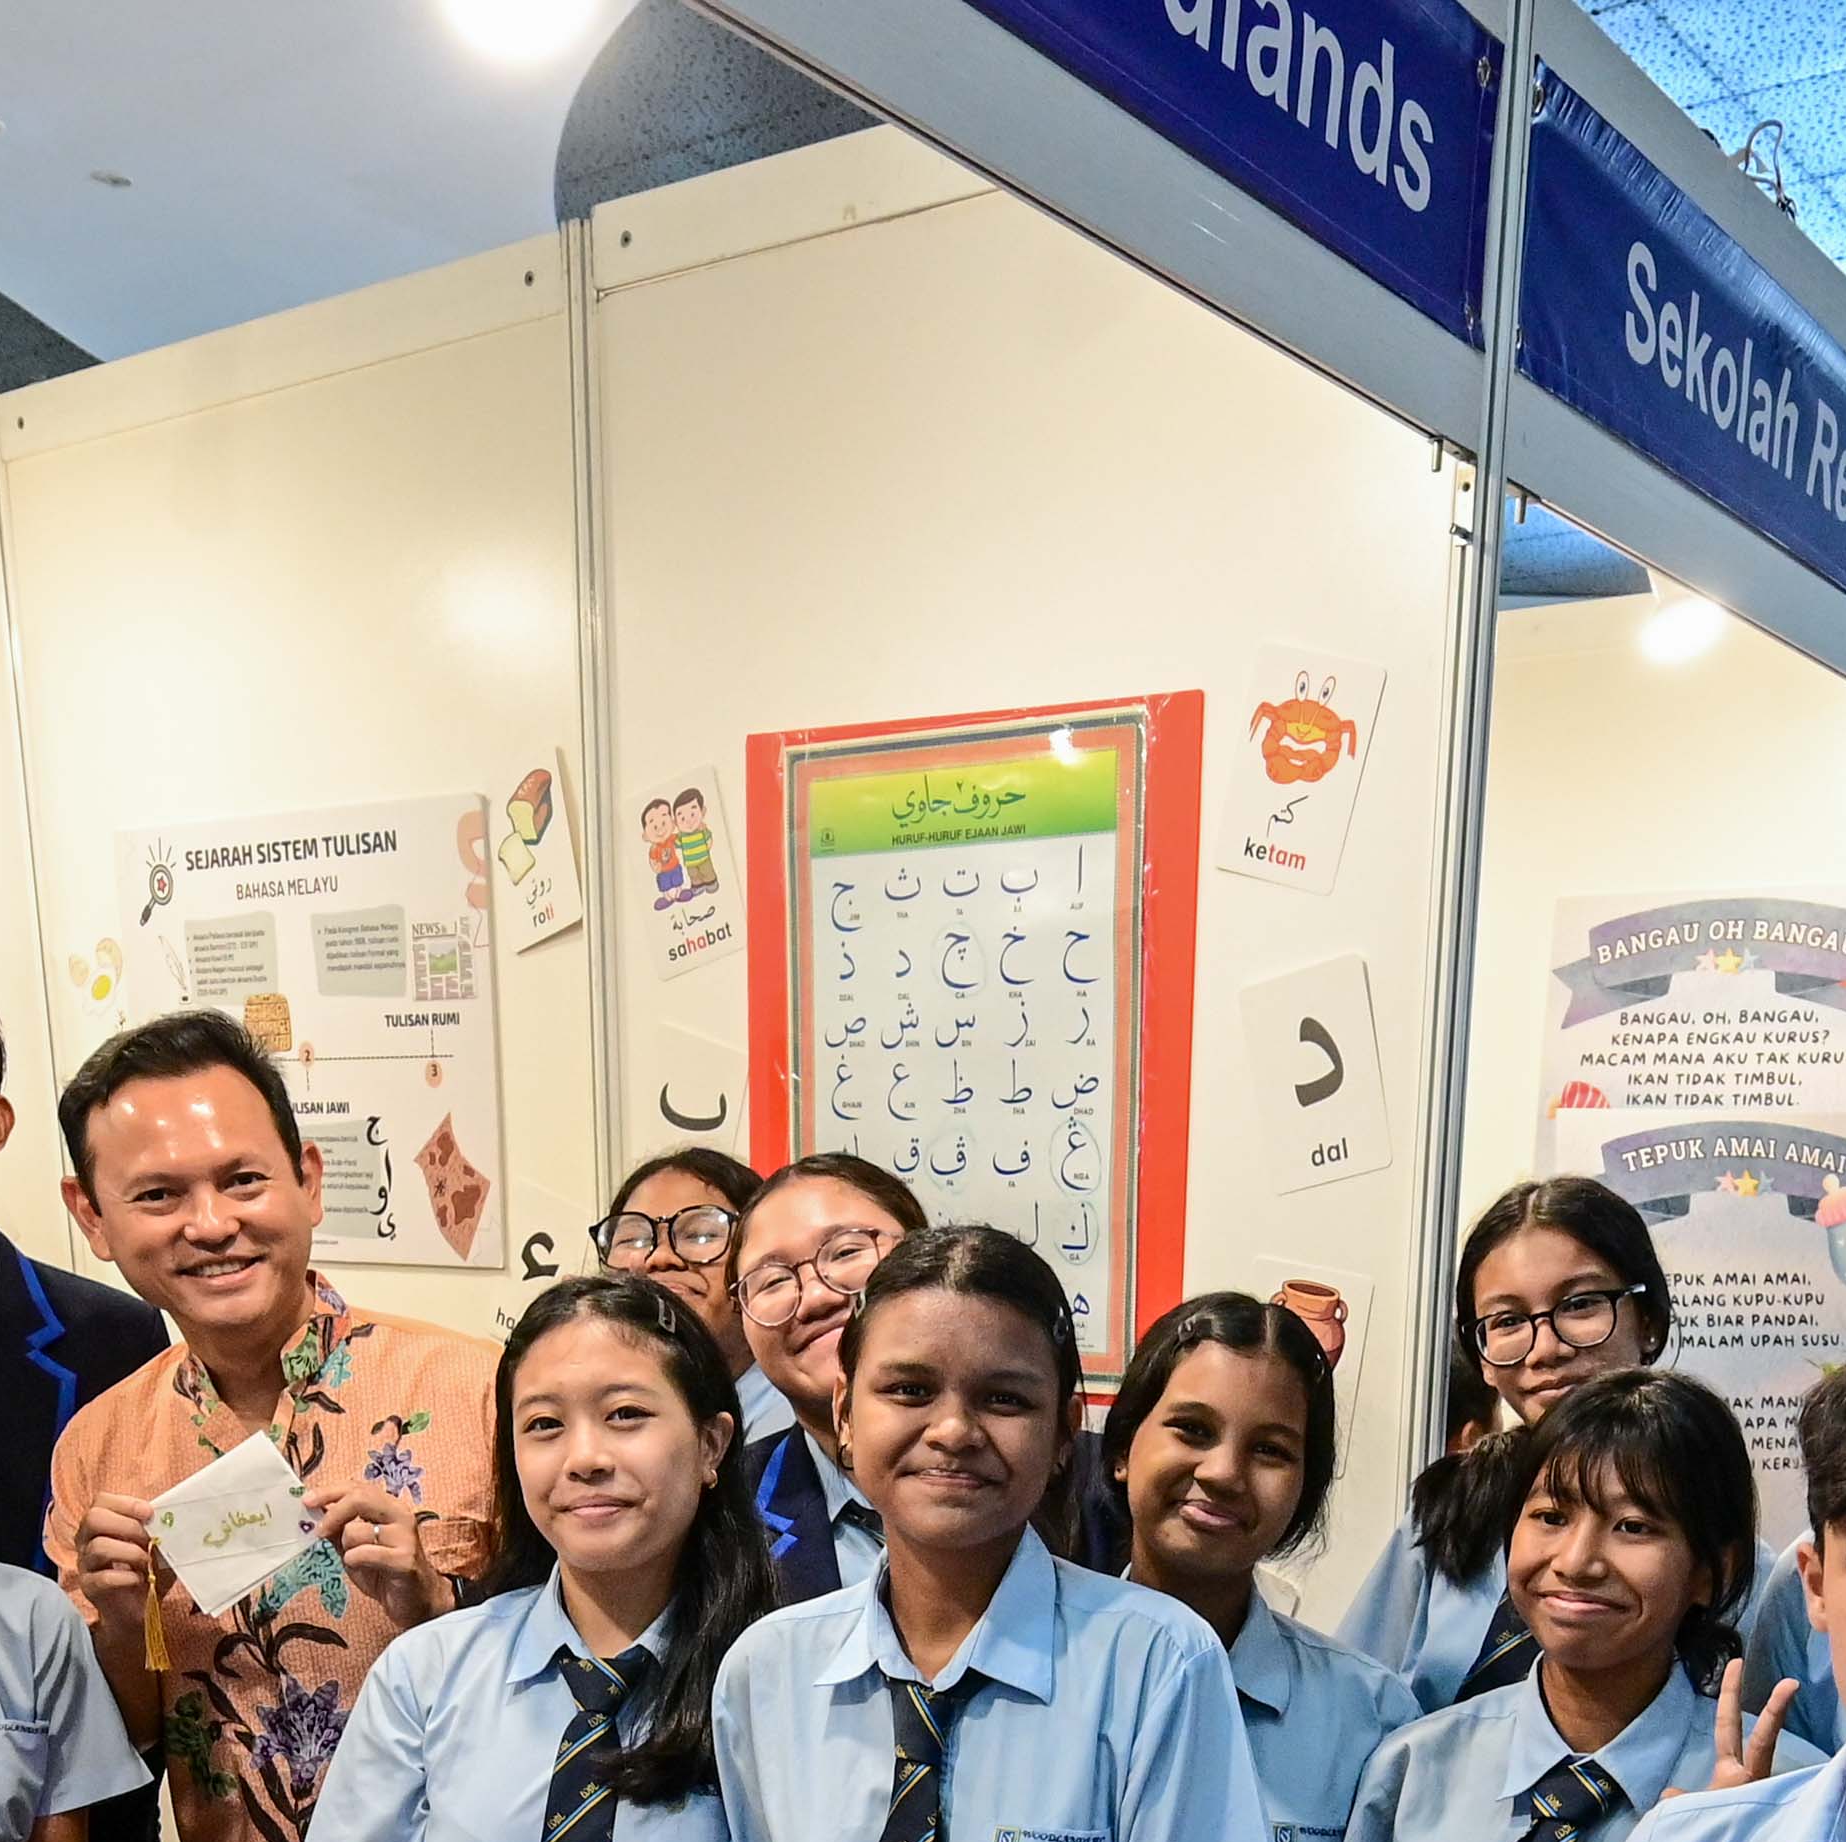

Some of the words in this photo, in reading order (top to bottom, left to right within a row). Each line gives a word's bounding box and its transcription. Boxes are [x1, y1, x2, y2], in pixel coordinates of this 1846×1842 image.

[1623, 244, 1800, 481] Sekolah
[892, 829, 962, 846] HURUF-HURUF
[965, 826, 999, 840] EJAAN
[1001, 823, 1026, 837] JAWI
[186, 844, 253, 871] SEJARAH
[256, 838, 318, 865] SISTEM
[322, 830, 397, 858] TULISAN
[1243, 838, 1307, 873] ketam
[236, 879, 285, 900] BAHASA
[287, 876, 339, 896] MELAYU
[532, 907, 555, 927] roti
[668, 922, 734, 963] sahabat
[1596, 923, 1700, 964] BANGAU
[1709, 920, 1744, 940] OH
[385, 1013, 430, 1028] TULISAN
[431, 1012, 461, 1026] RUMI
[1611, 1031, 1680, 1047] KENAPA
[1686, 1030, 1756, 1045] ENGKAU
[1762, 1029, 1830, 1044] KURUS?
[1294, 1016, 1345, 1108] د
[1580, 1052, 1646, 1067] MACAM
[1653, 1051, 1705, 1066] MANA
[1712, 1051, 1749, 1066] AKU
[1755, 1051, 1790, 1065] TAK
[1627, 1072, 1669, 1087] IKAN
[1676, 1072, 1726, 1087] TIDAK
[292, 1102, 324, 1114] ULISAN
[326, 1101, 350, 1114] JAWI
[1625, 1093, 1667, 1107] IKAN
[1674, 1093, 1725, 1107] TIDAK
[1310, 1137, 1350, 1167] dal
[1622, 1138, 1705, 1173] TEPUK
[1712, 1137, 1776, 1160] AMAI
[1784, 1142, 1846, 1174] AMAI
[1665, 1273, 1705, 1286] EPUK
[1712, 1273, 1756, 1286] AMAI
[1671, 1293, 1726, 1307] ALANG
[1733, 1293, 1825, 1306] KUPU-KUPU
[1706, 1314, 1746, 1327] BIAR
[1682, 1334, 1743, 1348] MALAM
[1750, 1334, 1795, 1347] UPAH
